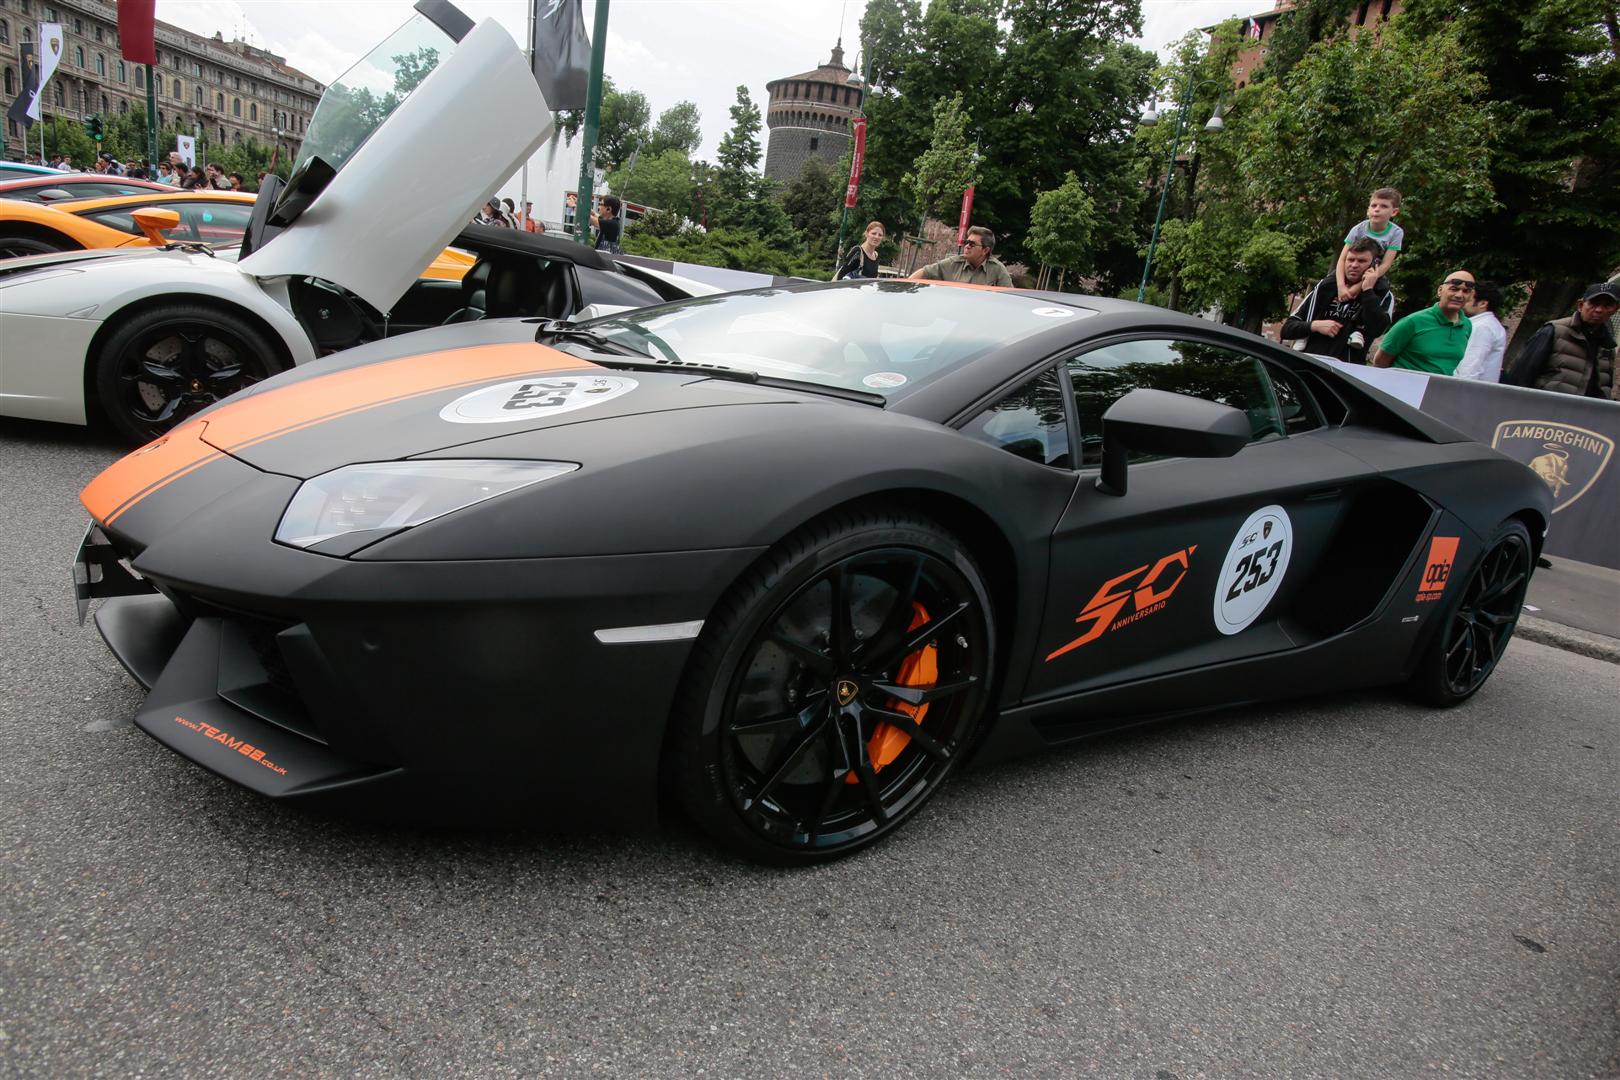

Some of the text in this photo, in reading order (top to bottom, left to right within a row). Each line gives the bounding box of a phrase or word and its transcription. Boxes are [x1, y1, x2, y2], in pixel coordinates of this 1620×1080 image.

[502, 381, 578, 410] 253
[1503, 426, 1604, 455] LAMBORGHINI
[1225, 539, 1284, 603] 253
[1045, 544, 1198, 662] 50
[1111, 601, 1167, 632] ANNIVERSARIO
